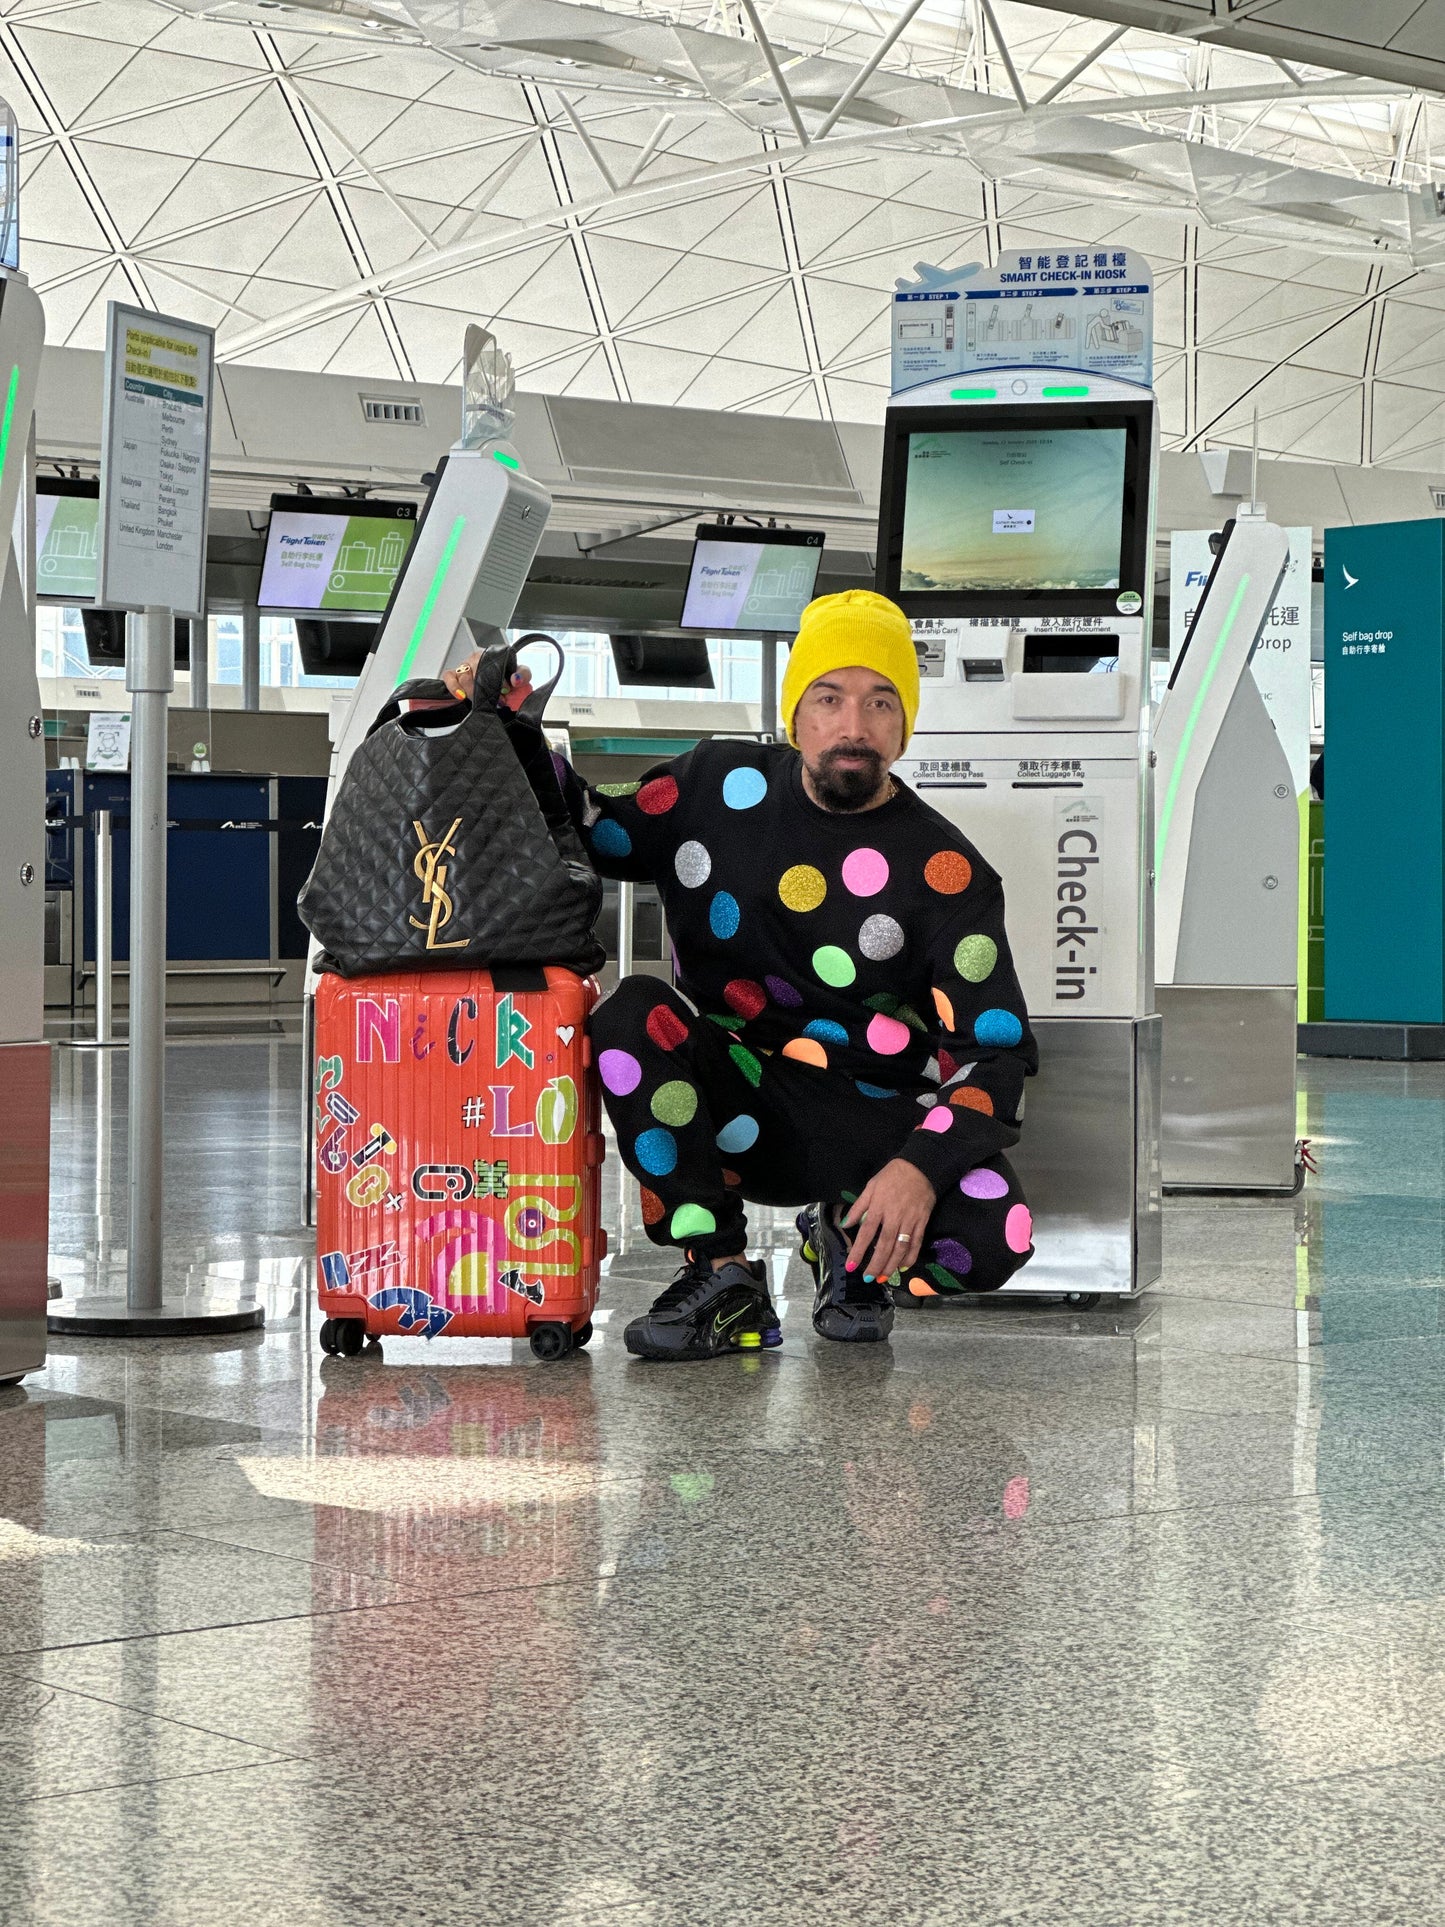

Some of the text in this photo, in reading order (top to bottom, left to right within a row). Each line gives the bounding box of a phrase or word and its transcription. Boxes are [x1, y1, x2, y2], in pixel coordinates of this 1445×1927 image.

[1000, 268, 1126, 283] SMART CHECK-IN KIOSK
[126, 380, 145, 394] Country
[162, 412, 186, 425] Melbourne
[162, 424, 174, 434] Perth
[123, 441, 138, 451] Japan
[161, 436, 178, 448] Sydney
[161, 448, 180, 459] Fukuoka
[182, 452, 200, 464] Nagoya
[160, 459, 176, 470] Osaka
[178, 463, 196, 474] Sapporo
[121, 475, 142, 488] Malaysia
[160, 470, 174, 482] Tokyo
[159, 483, 189, 497] Kuala Lumpur
[120, 499, 140, 511] Thailand
[158, 494, 176, 506] Penang
[158, 506, 177, 517] Bangkok
[396, 508, 411, 517] C3
[158, 517, 174, 528] Phuket
[120, 522, 155, 538] United Kingdom
[157, 530, 182, 542] Manchester
[156, 540, 174, 551] London
[806, 536, 818, 545] C4
[1342, 630, 1393, 642] Self bag drop
[920, 762, 971, 772] 取回登機證
[1042, 771, 1071, 779] Luggage
[1056, 828, 1100, 1000] Check-in
